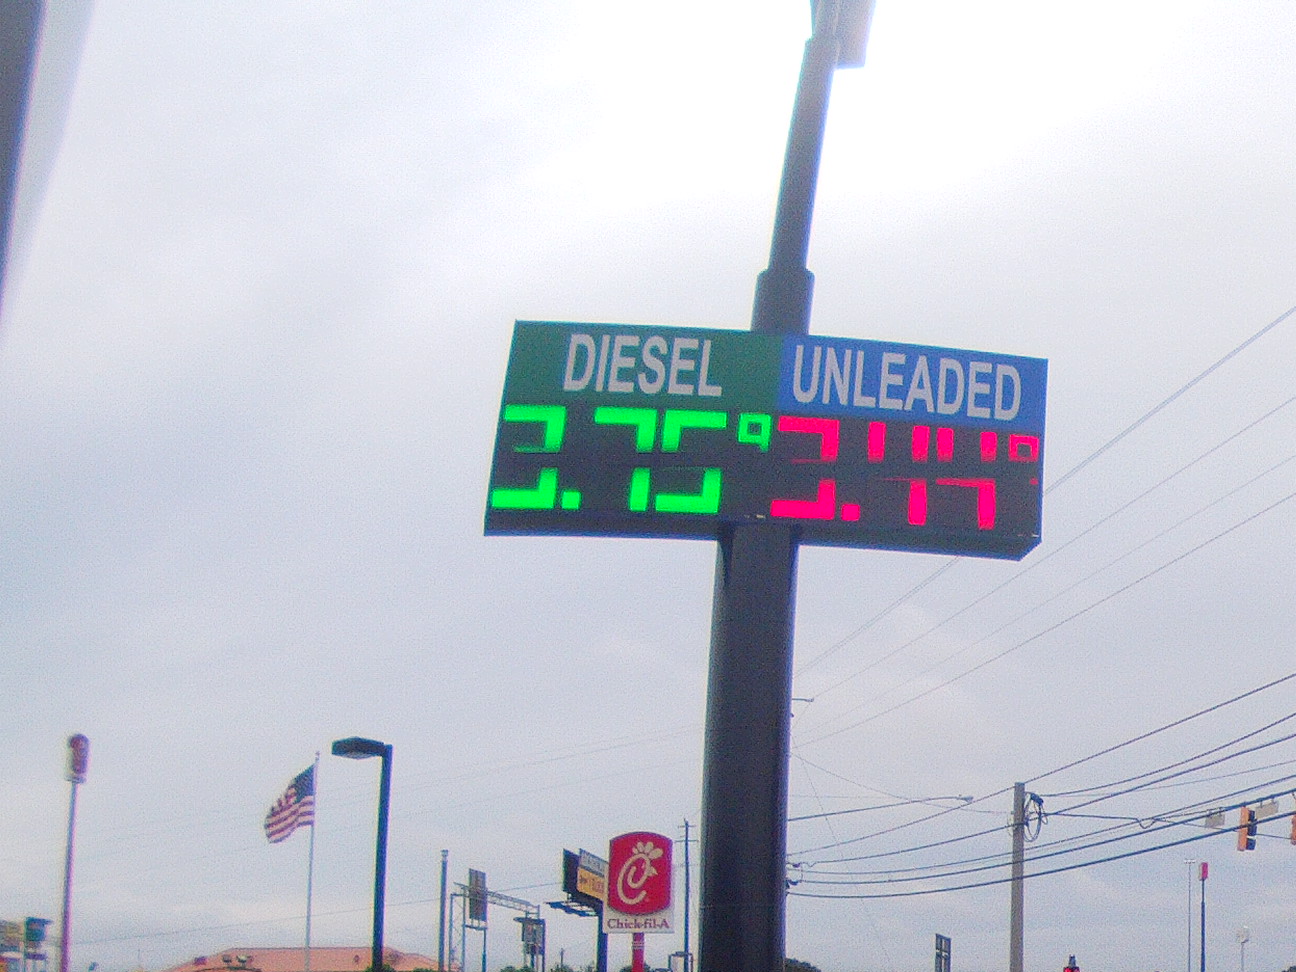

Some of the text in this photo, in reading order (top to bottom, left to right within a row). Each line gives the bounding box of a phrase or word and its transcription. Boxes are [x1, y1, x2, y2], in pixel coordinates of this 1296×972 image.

[562, 333, 723, 397] DIESEL
[792, 345, 1022, 421] UNLEADED
[607, 918, 670, 930] Chick-fil-A
